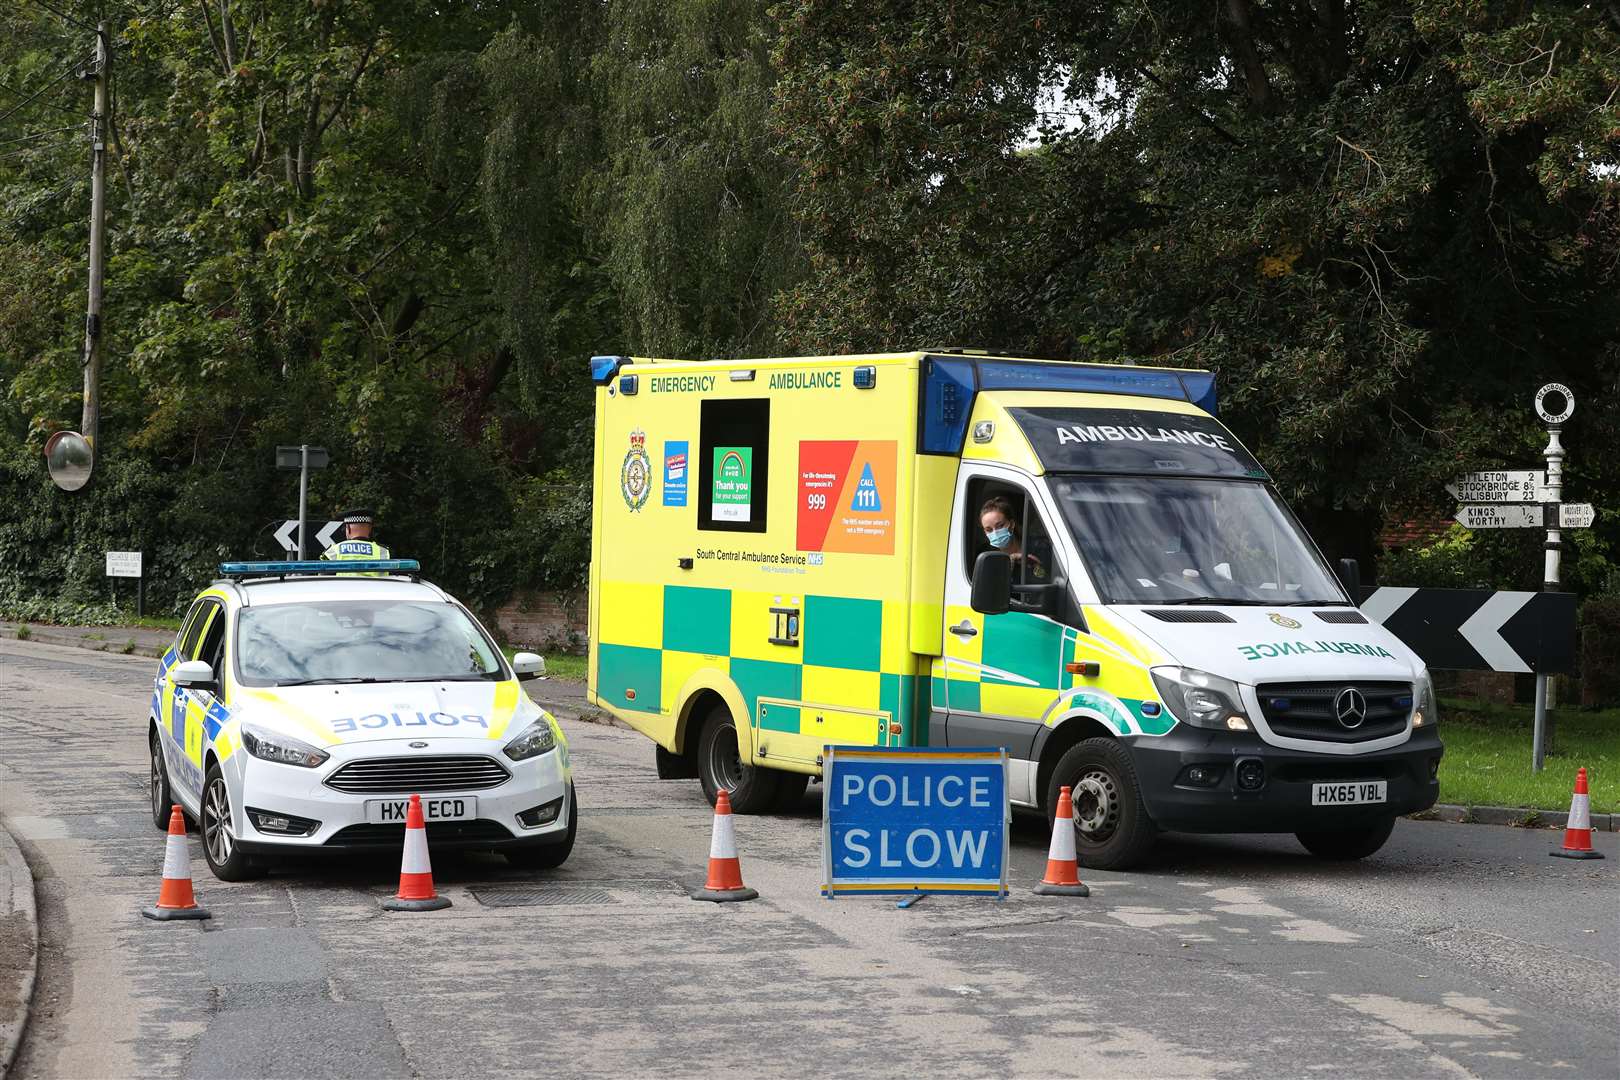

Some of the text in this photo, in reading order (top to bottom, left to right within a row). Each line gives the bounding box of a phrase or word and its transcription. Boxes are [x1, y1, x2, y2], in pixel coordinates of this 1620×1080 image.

[651, 372, 841, 392] EMERGENCY AMBULANCE
[1536, 384, 1573, 400] HEADBOURNE
[1542, 412, 1568, 422] WORTHY
[1056, 426, 1235, 452] AMBULANCE
[1528, 472, 1534, 481] 2
[716, 481, 748, 492] Thank you
[1458, 482, 1519, 491] STOCKBRIDGE
[808, 494, 826, 510] 999
[857, 490, 876, 507] 111
[1458, 492, 1534, 500] SALISBURY 23
[1468, 508, 1495, 516] KINGS
[1468, 517, 1506, 526] WORTHY
[340, 543, 372, 554] POLICE
[696, 549, 823, 565] South Central Ambulance Service NHS
[842, 774, 990, 807] POLICE
[1319, 784, 1382, 802] HX65 VBL
[381, 800, 464, 820] HX ECD
[842, 828, 989, 868] SLOW
